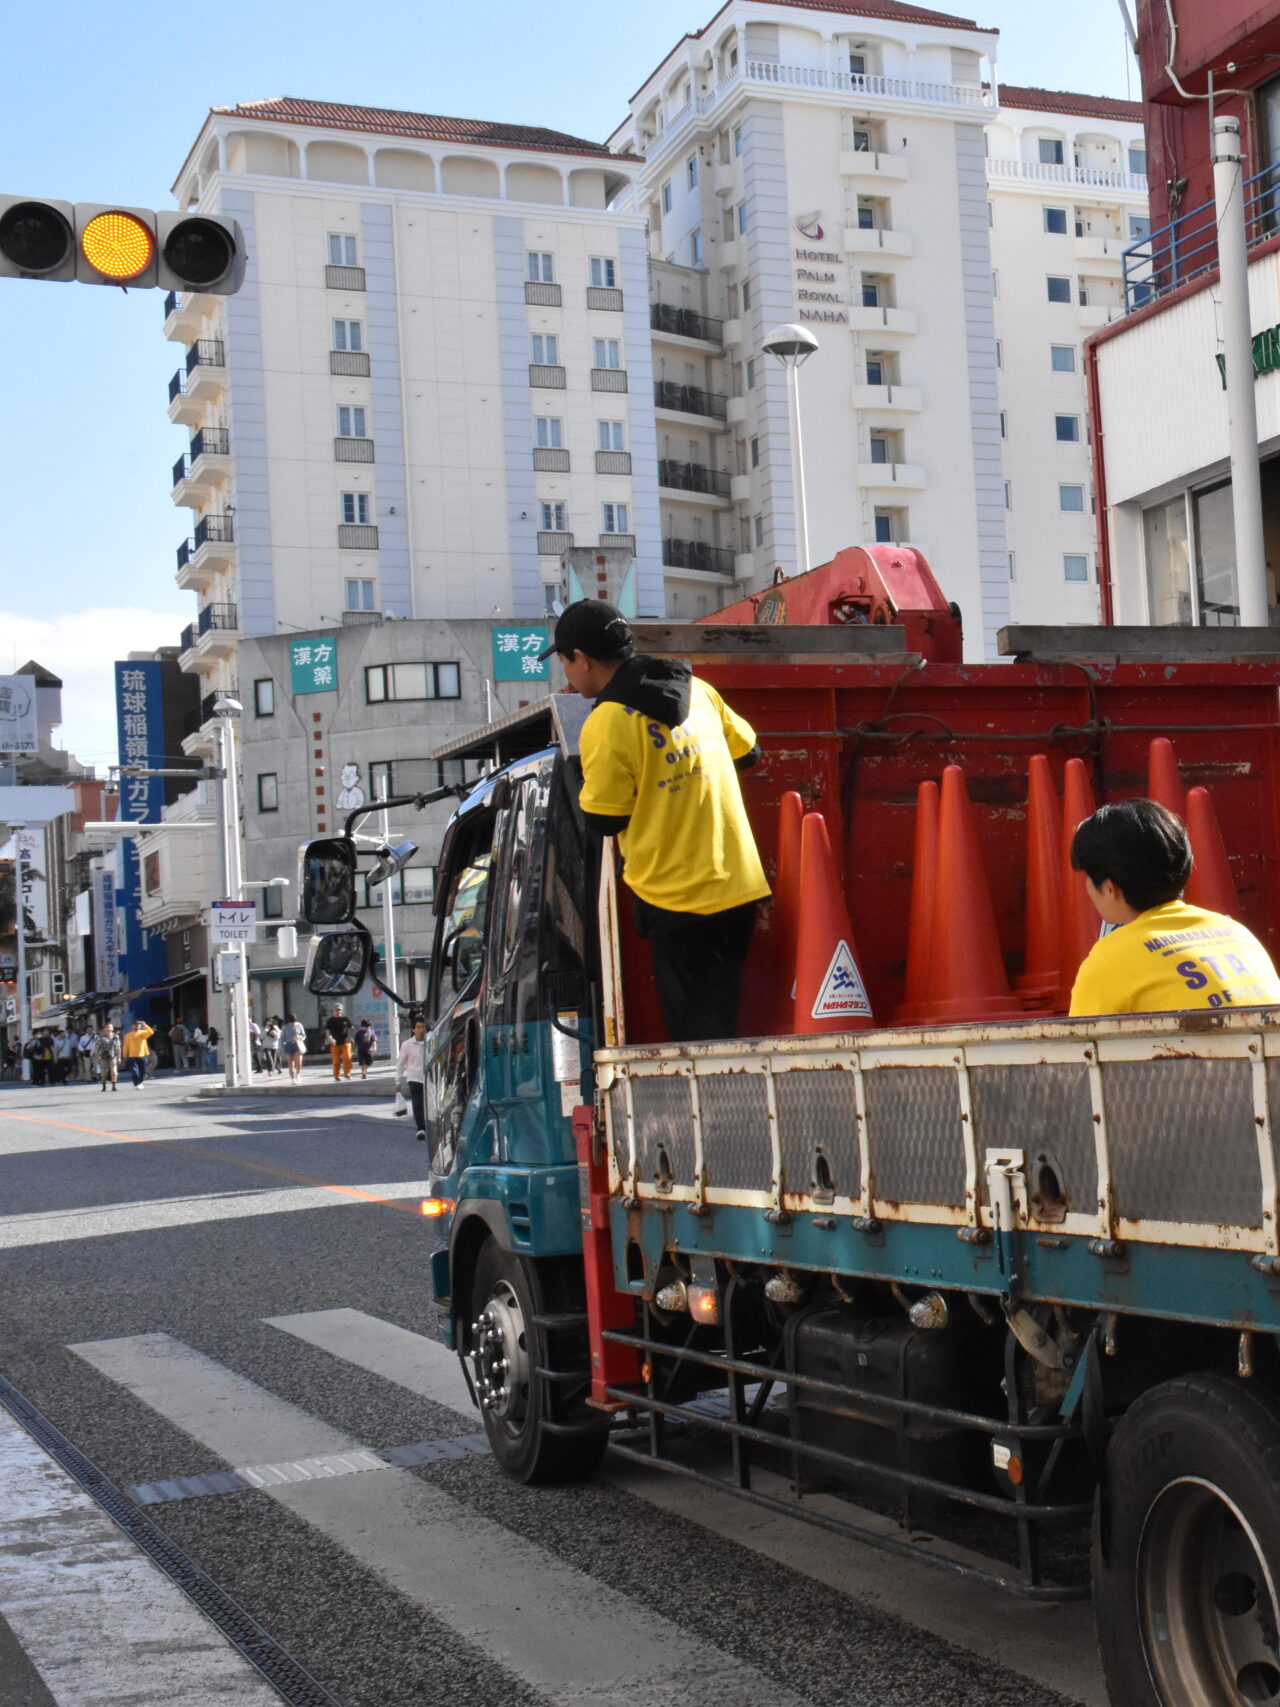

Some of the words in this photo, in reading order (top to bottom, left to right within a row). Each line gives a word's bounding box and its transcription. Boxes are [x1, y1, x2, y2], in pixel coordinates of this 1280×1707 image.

[796, 248, 843, 264] HOTEL
[797, 268, 835, 282] PALM
[798, 288, 844, 304] ROYAL
[799, 308, 847, 323] NAHA
[497, 633, 545, 652] 漢方
[293, 644, 332, 666] 漢方
[521, 655, 543, 674] 薬
[314, 666, 332, 685] 薬
[219, 911, 250, 923] トイレ
[219, 930, 249, 939] TOILET
